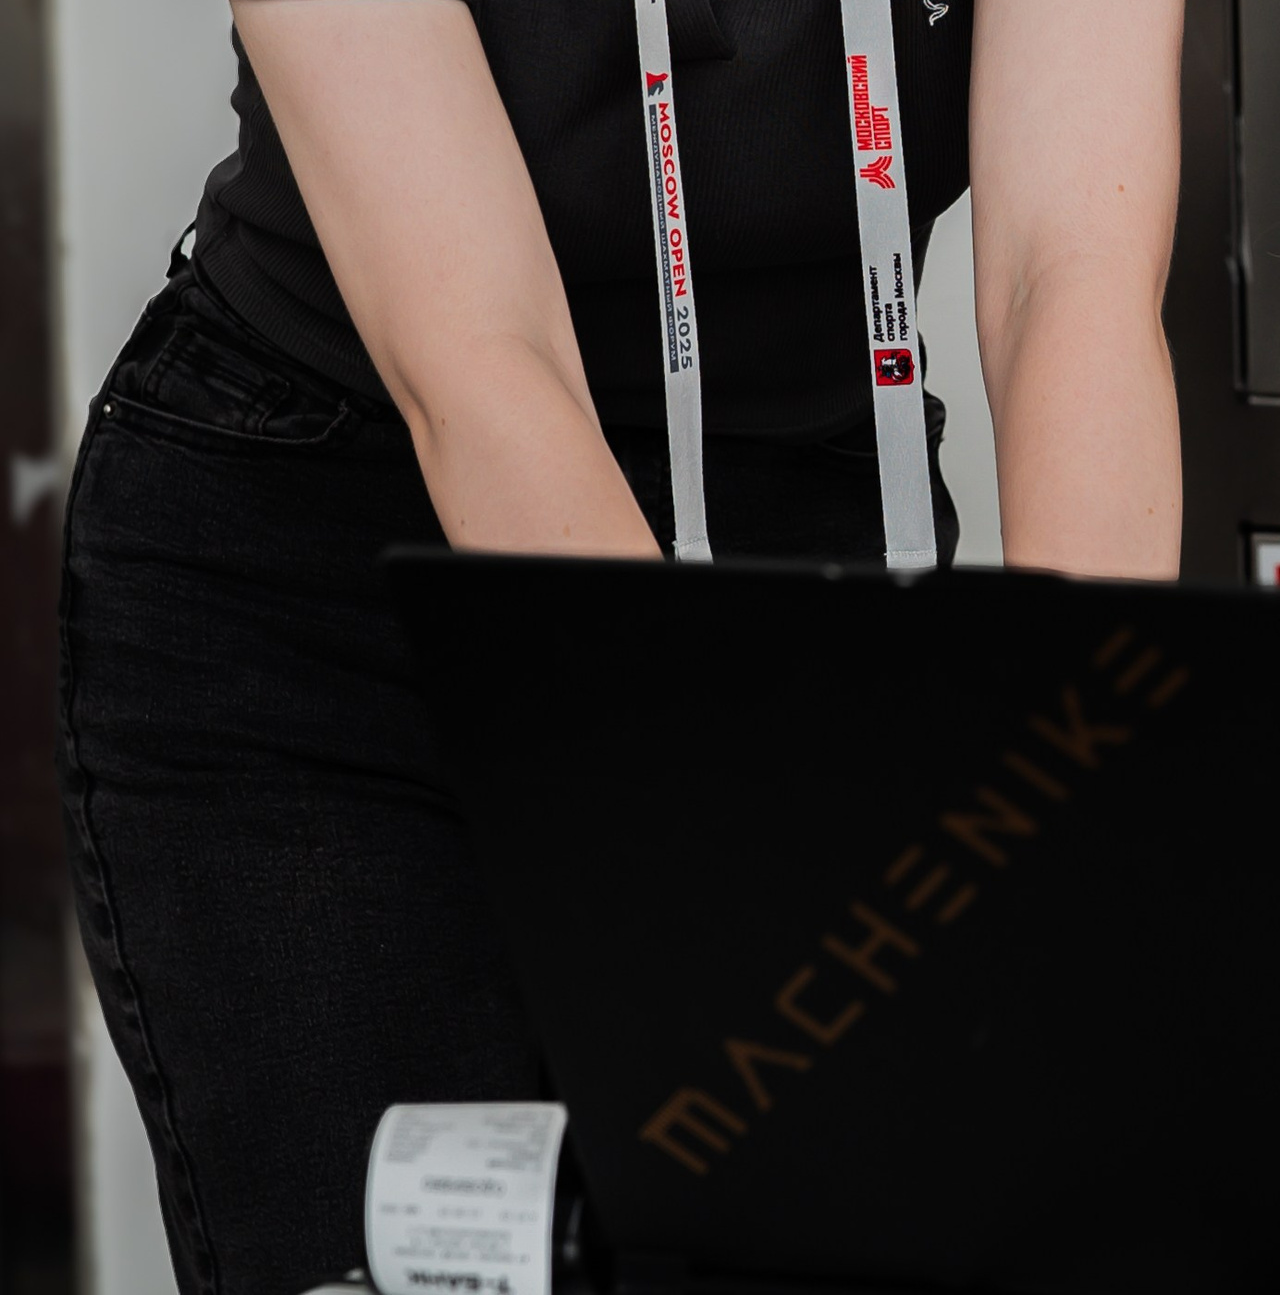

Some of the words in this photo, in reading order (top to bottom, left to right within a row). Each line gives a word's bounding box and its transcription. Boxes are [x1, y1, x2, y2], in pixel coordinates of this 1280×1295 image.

[847, 54, 873, 151] МОСКОВСКИЙ
[870, 105, 893, 150] СПОРТ
[658, 102, 680, 220] MOSCOW
[669, 228, 687, 298] OPEN
[893, 253, 904, 299] Москвы
[869, 265, 885, 343] Департамент
[884, 302, 896, 343] спорта
[897, 303, 908, 342] города
[676, 305, 693, 371] 2025
